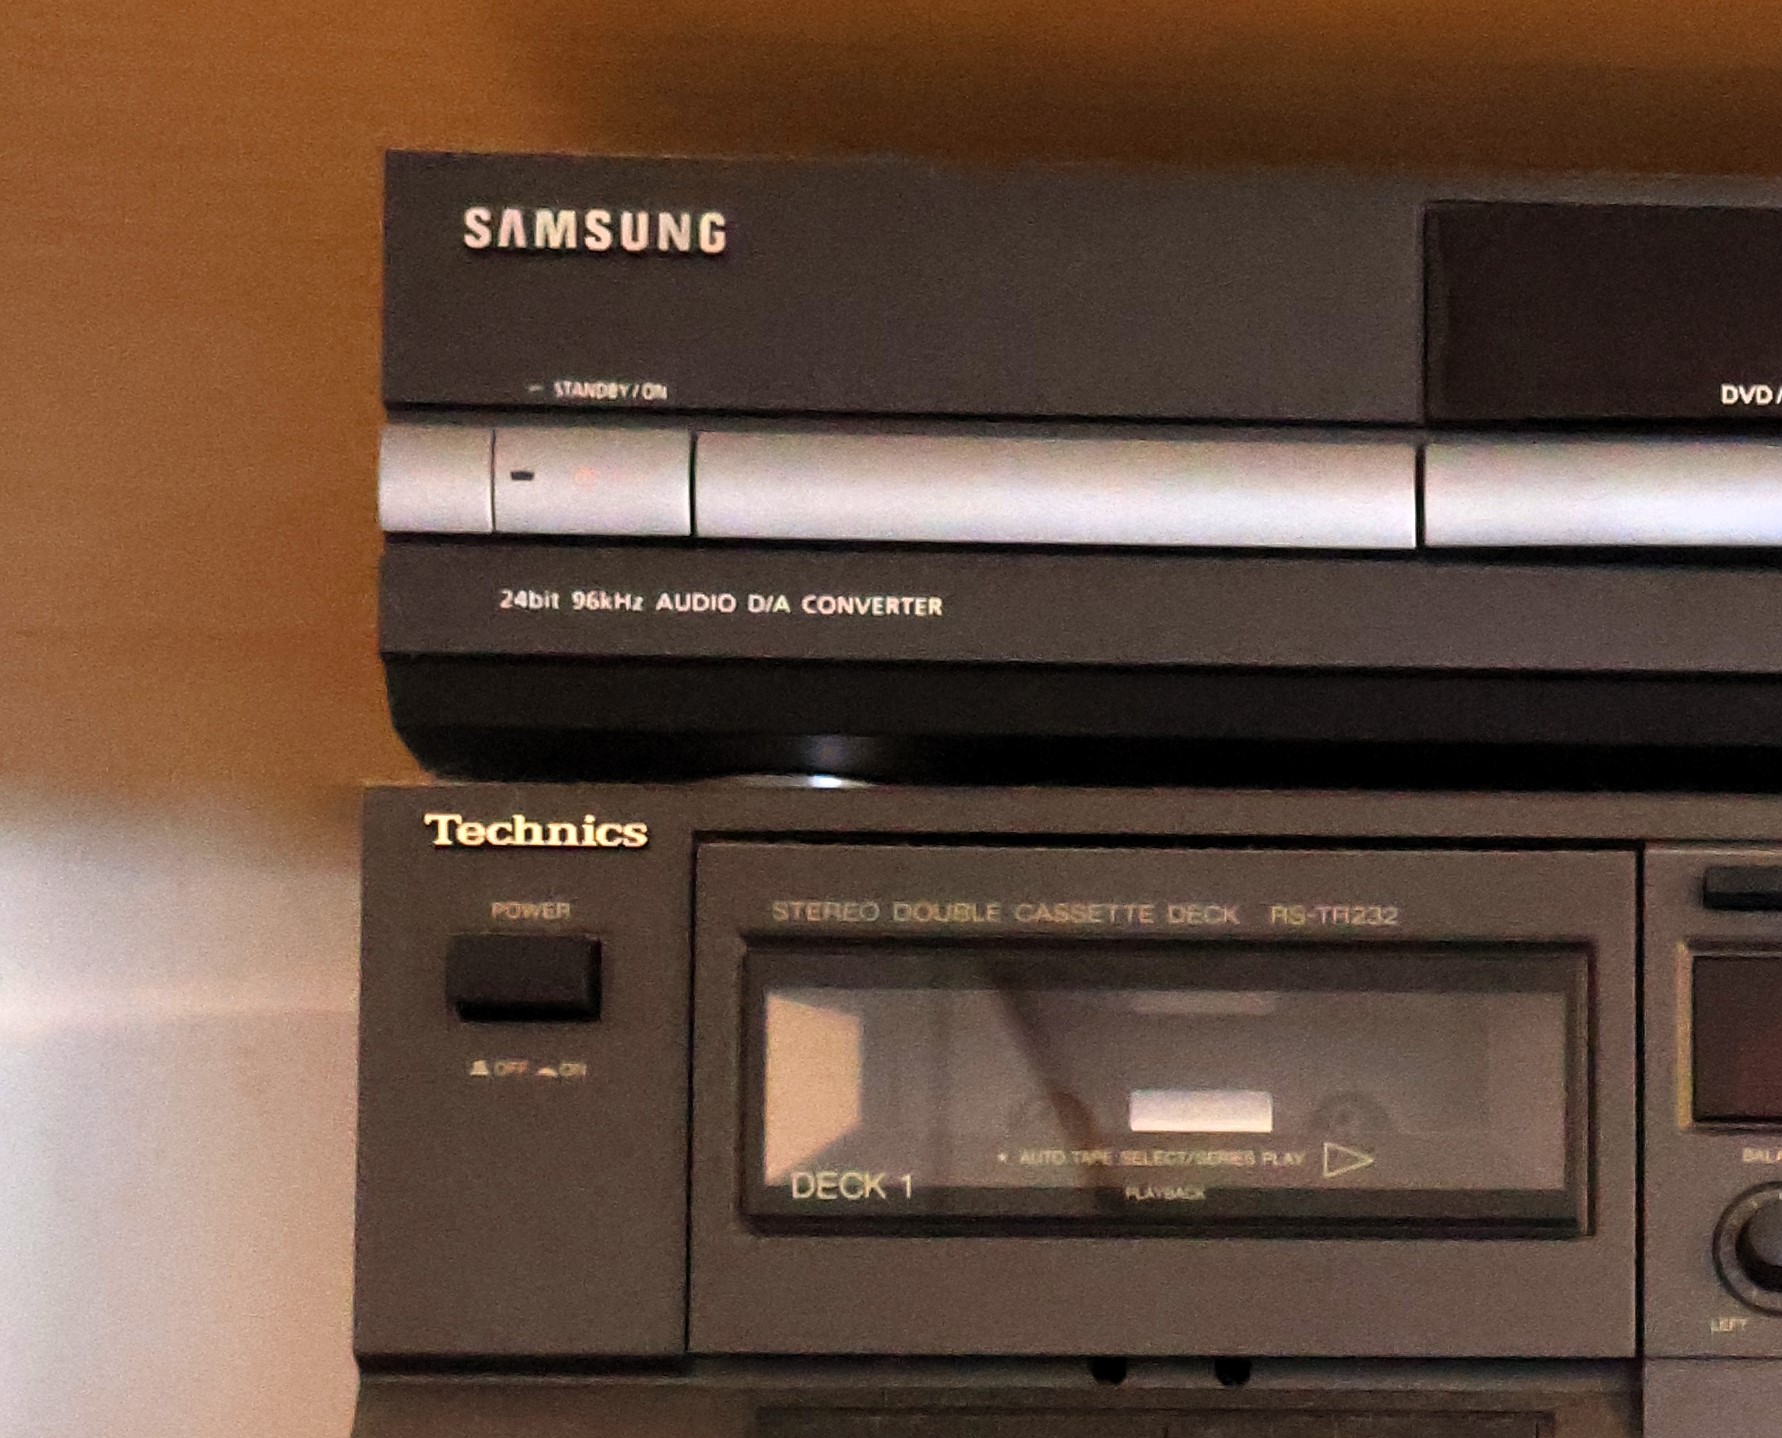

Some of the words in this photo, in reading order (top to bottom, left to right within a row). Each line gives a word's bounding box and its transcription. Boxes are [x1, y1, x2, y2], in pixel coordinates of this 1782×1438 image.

[464, 208, 726, 254] SAMSUNG
[499, 590, 560, 611] 24bit
[572, 591, 643, 611] 96kHz
[656, 593, 736, 613] AUDIO
[747, 594, 791, 614] D/A
[801, 595, 943, 618] CONVERTER
[424, 814, 649, 848] Technics
[492, 902, 571, 919] POWER
[773, 902, 879, 921] STEREO
[894, 902, 1000, 922] DOUBLE
[1014, 904, 1154, 925] CASSETTE
[1168, 905, 1239, 925] DECK
[1270, 906, 1398, 926] RS-TR232
[1020, 1150, 1065, 1166] AUTO
[1263, 1152, 1305, 1167] PLAY
[791, 1171, 887, 1201] DECK
[900, 1174, 912, 1198] 1
[1126, 1186, 1206, 1200] PLAYBACK
